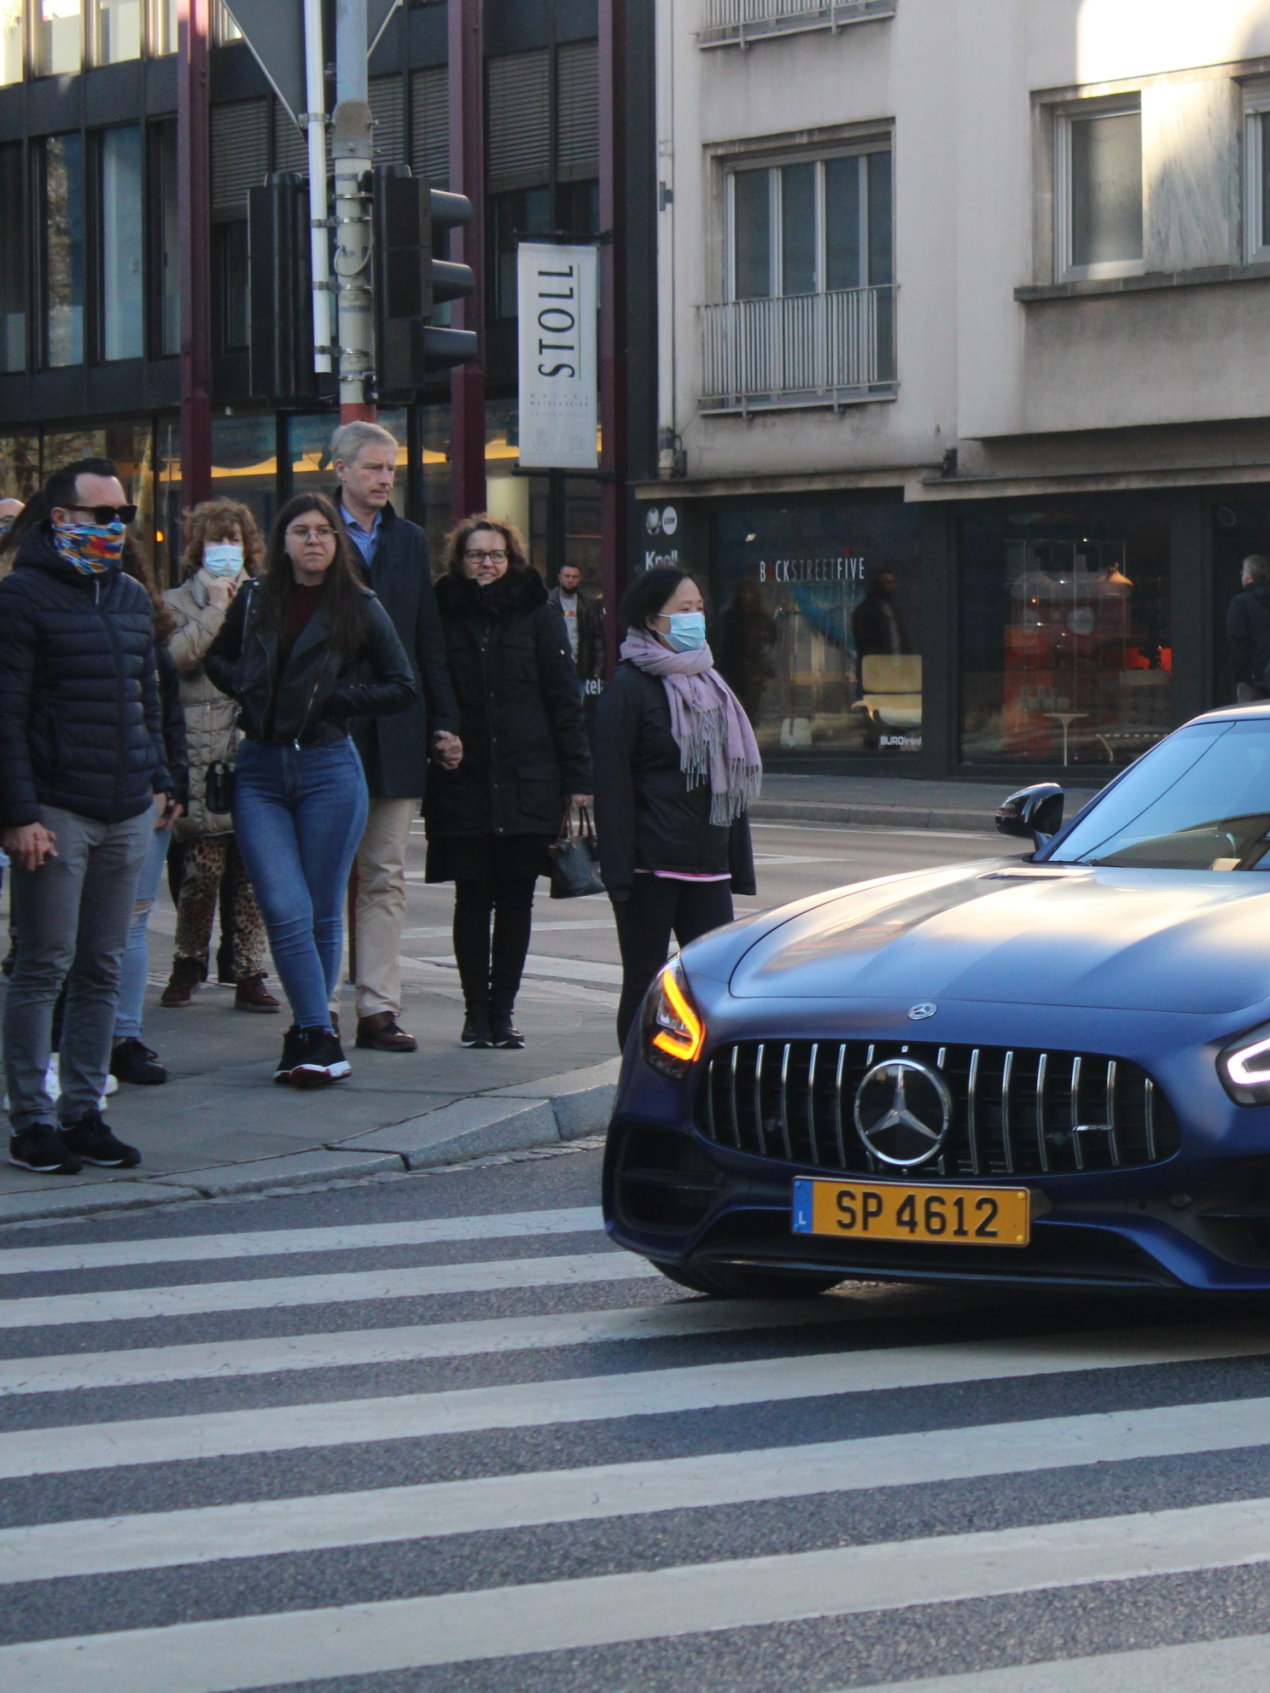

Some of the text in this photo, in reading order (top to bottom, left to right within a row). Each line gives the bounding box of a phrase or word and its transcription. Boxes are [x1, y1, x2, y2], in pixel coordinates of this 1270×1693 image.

[538, 265, 575, 378] STOLL
[798, 1189, 998, 1238] L SP 4612
